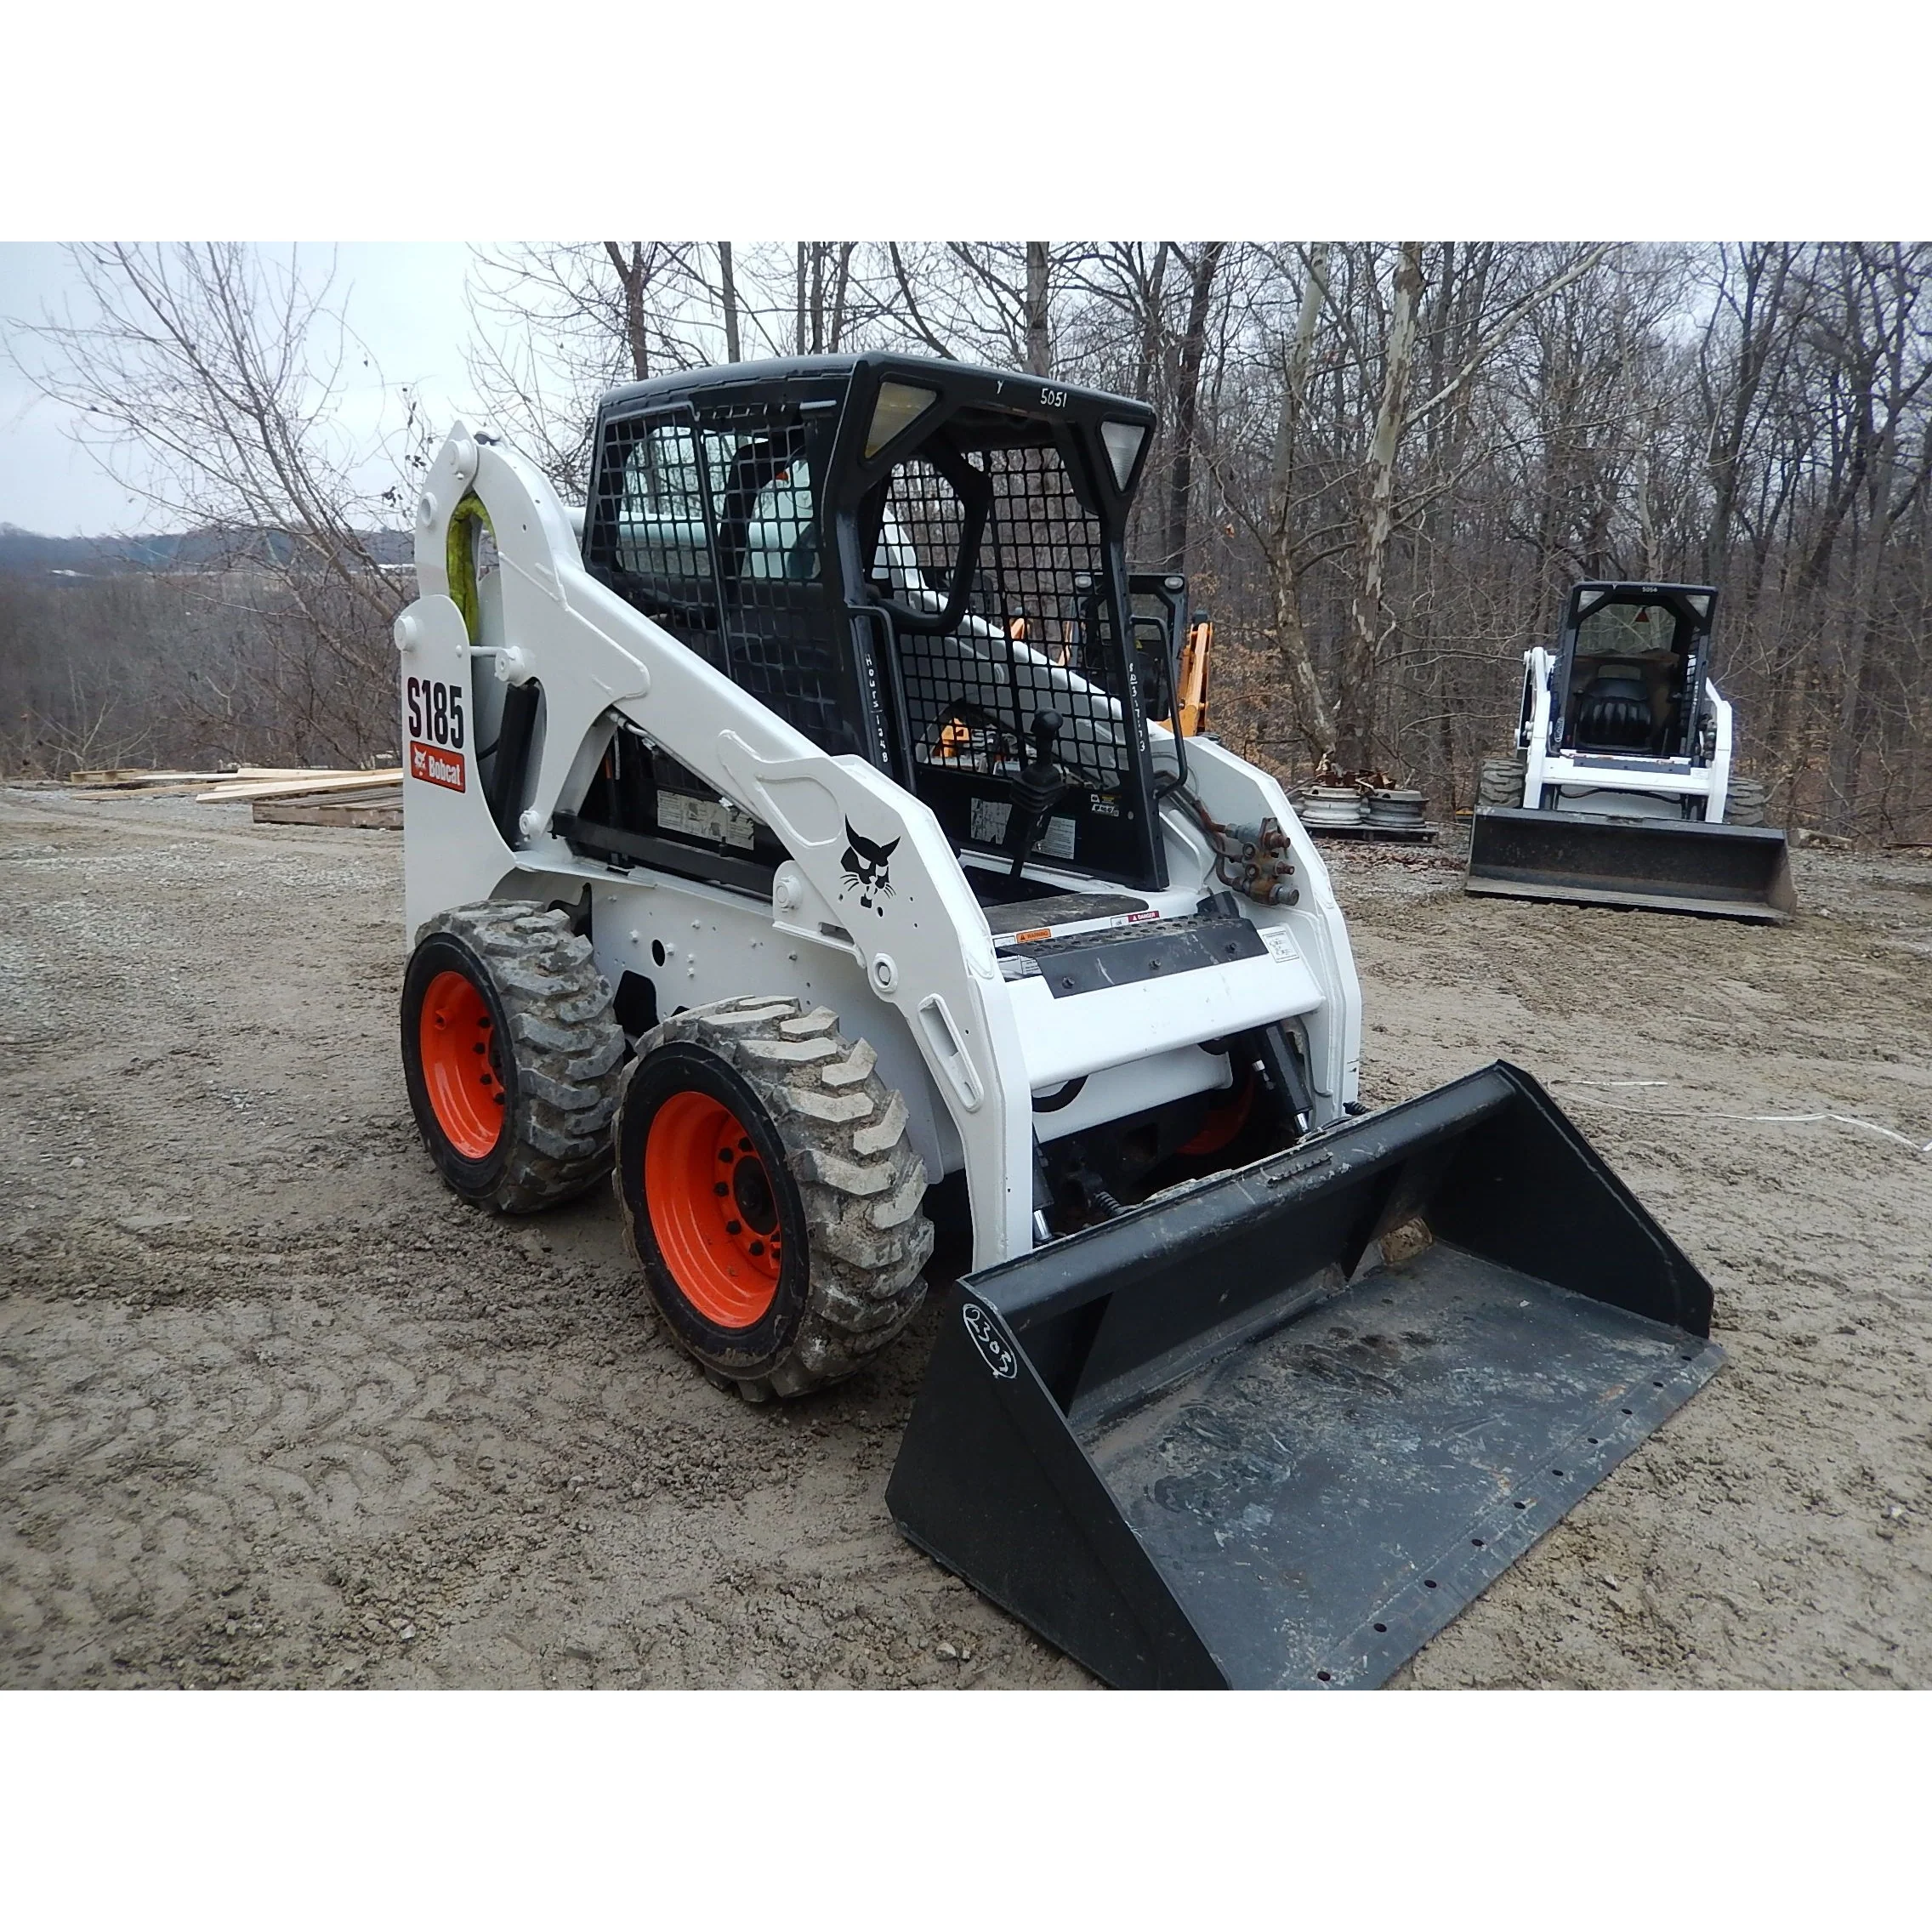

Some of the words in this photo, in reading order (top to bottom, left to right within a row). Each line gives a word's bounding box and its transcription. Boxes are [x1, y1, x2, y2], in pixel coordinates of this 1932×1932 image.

[1040, 387, 1067, 408] 5051
[407, 677, 464, 749] S185
[429, 755, 461, 786] Bobcat
